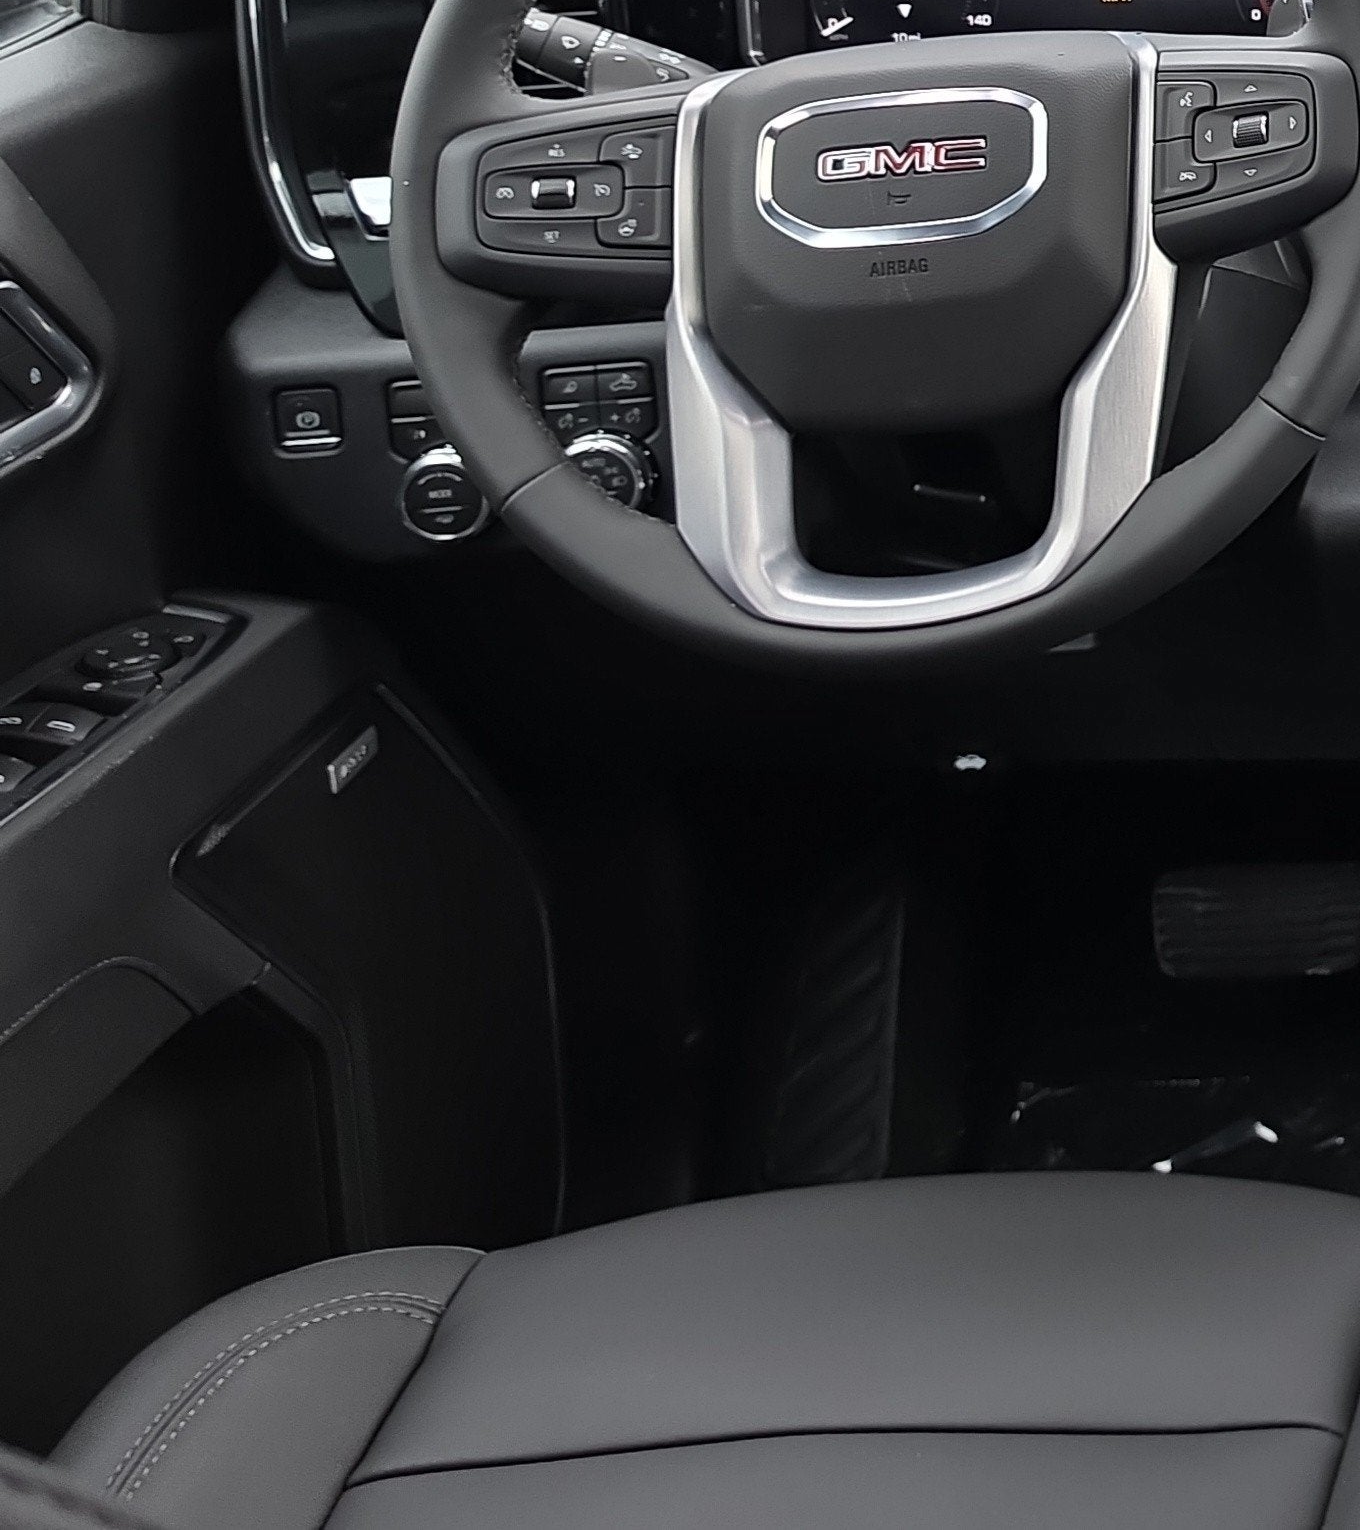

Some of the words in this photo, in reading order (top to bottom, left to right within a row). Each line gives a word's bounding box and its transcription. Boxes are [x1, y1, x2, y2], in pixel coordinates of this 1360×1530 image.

[966, 15, 992, 27] 140
[1251, 9, 1262, 21] 0
[817, 135, 987, 182] GMC
[870, 258, 929, 278] AIRBAG
